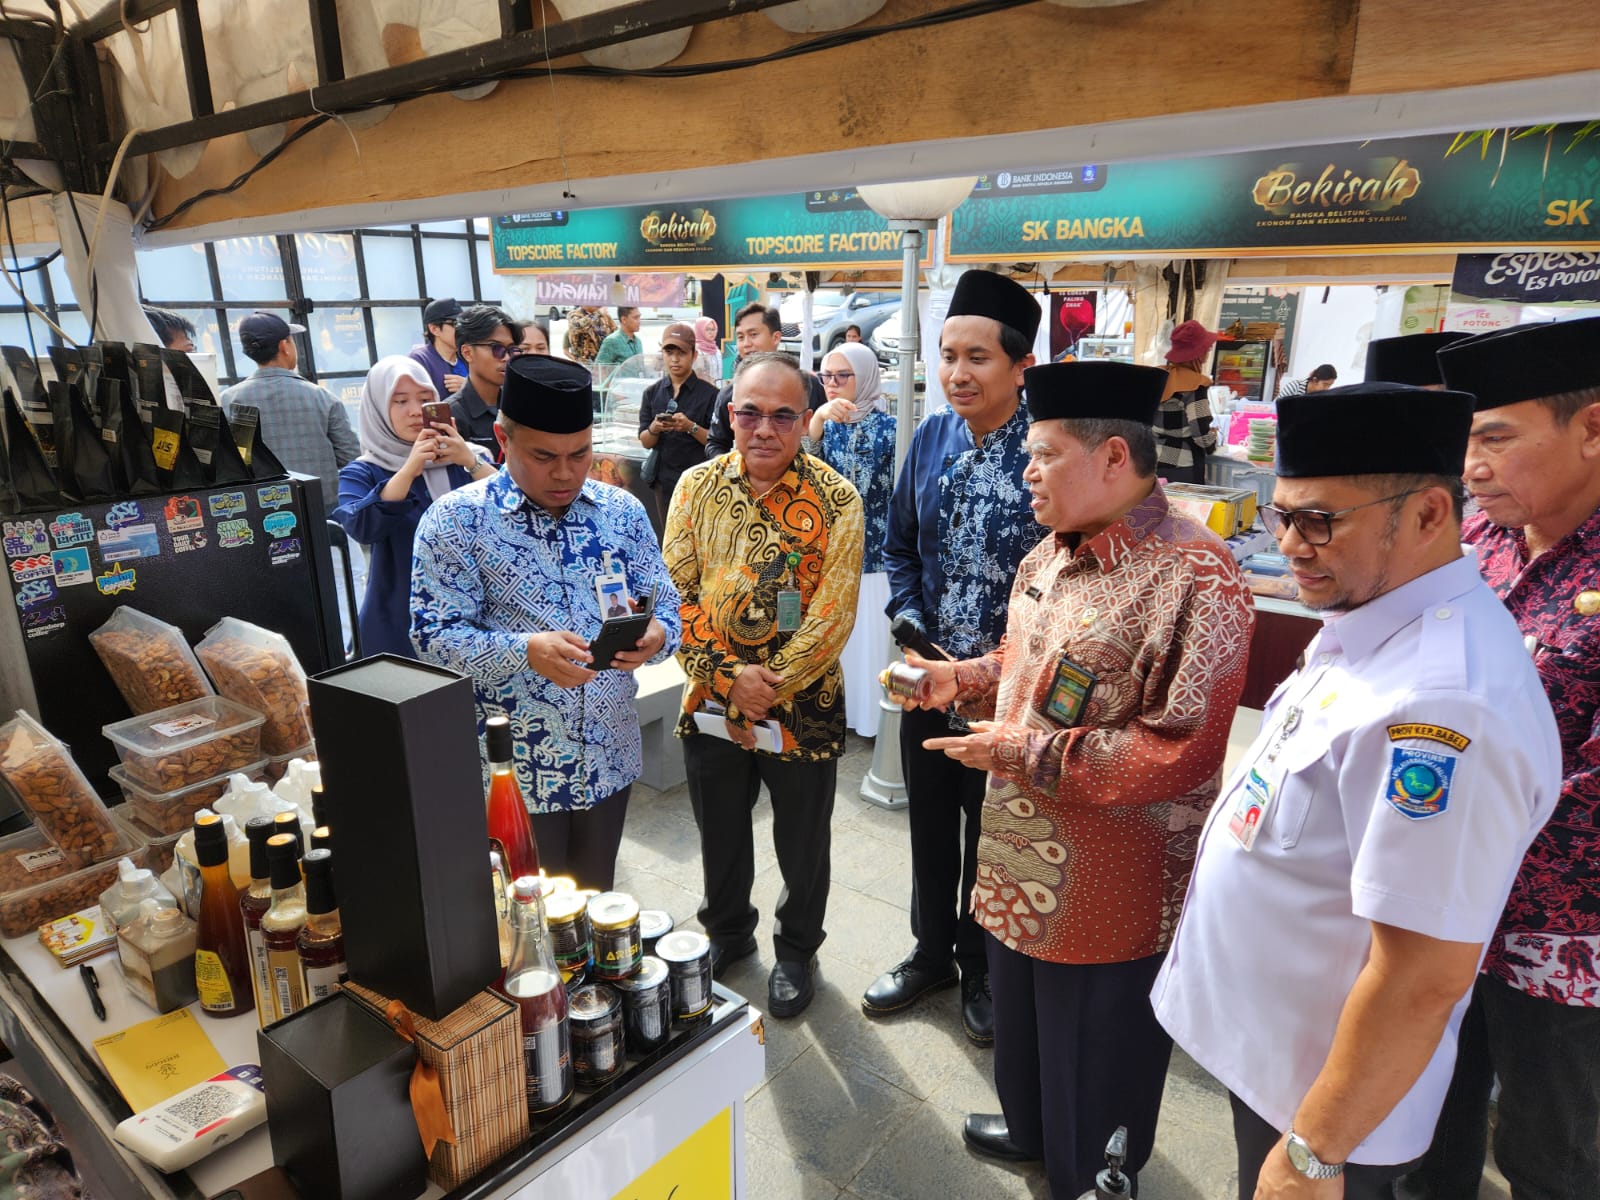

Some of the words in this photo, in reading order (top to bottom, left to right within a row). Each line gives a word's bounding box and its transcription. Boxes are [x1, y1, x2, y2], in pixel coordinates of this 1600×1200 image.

[1012, 174, 1032, 184] BANK
[1033, 171, 1073, 182] INDONESIA
[1264, 159, 1409, 208] Bekisah
[1256, 219, 1295, 227] EKONOMI
[1296, 218, 1315, 226] DAN
[1317, 217, 1366, 225] KEUANGAN
[1367, 215, 1408, 223] SYARIAH
[1290, 211, 1325, 219] BANGKA
[1327, 210, 1371, 218] BELITUNG
[1543, 198, 1593, 227] SK
[647, 209, 711, 242] Bekisah
[1022, 220, 1050, 241] SK
[1055, 216, 1145, 240] BANGKA
[506, 244, 564, 261] TOPSCORE
[566, 242, 618, 259] FACTORY
[745, 234, 825, 256] TOPSCORE
[829, 230, 904, 252] FACTORY
[7, 544, 33, 556] STEP
